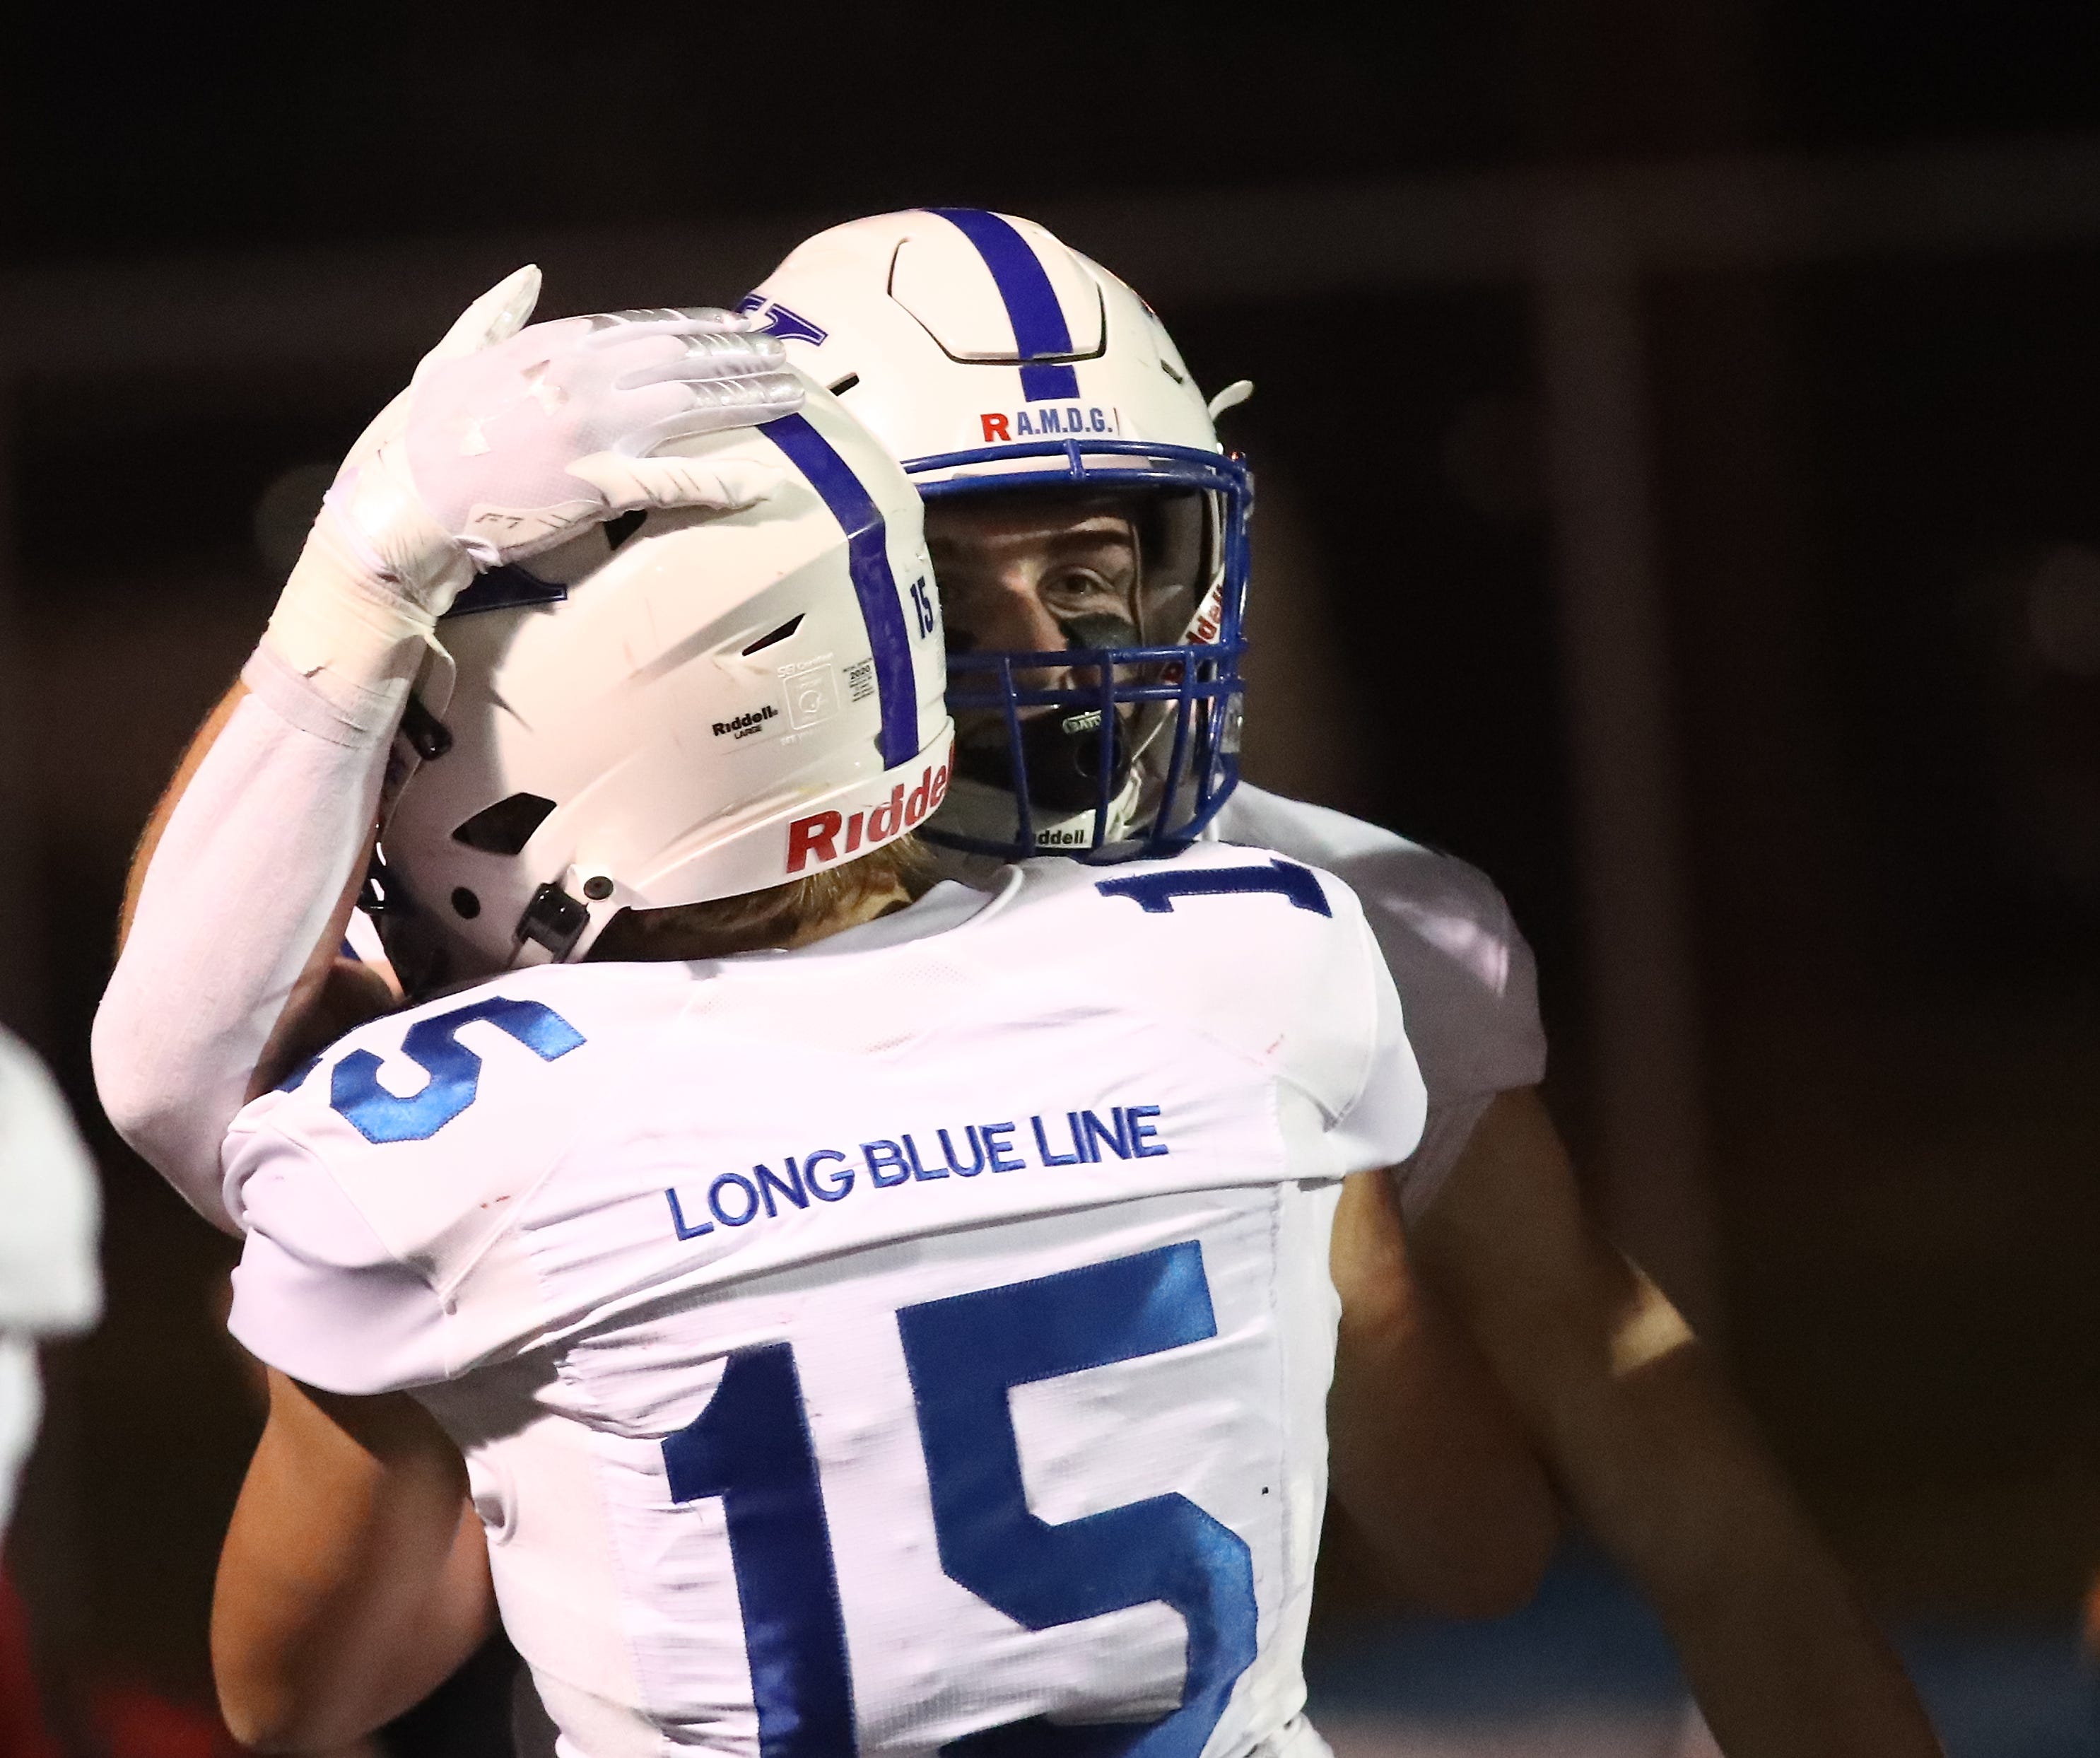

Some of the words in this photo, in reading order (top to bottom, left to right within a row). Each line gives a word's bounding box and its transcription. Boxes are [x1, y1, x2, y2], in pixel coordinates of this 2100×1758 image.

[980, 413, 1011, 442] R
[1017, 407, 1113, 435] A.M.D.G.
[910, 575, 934, 639] 15
[711, 705, 775, 737] Riddell
[1034, 830, 1085, 845] ddell
[664, 1149, 855, 1241] LONG
[859, 1121, 1026, 1189] BLUE
[1030, 1105, 1170, 1167] LINE
[662, 1239, 1258, 1758] 15
